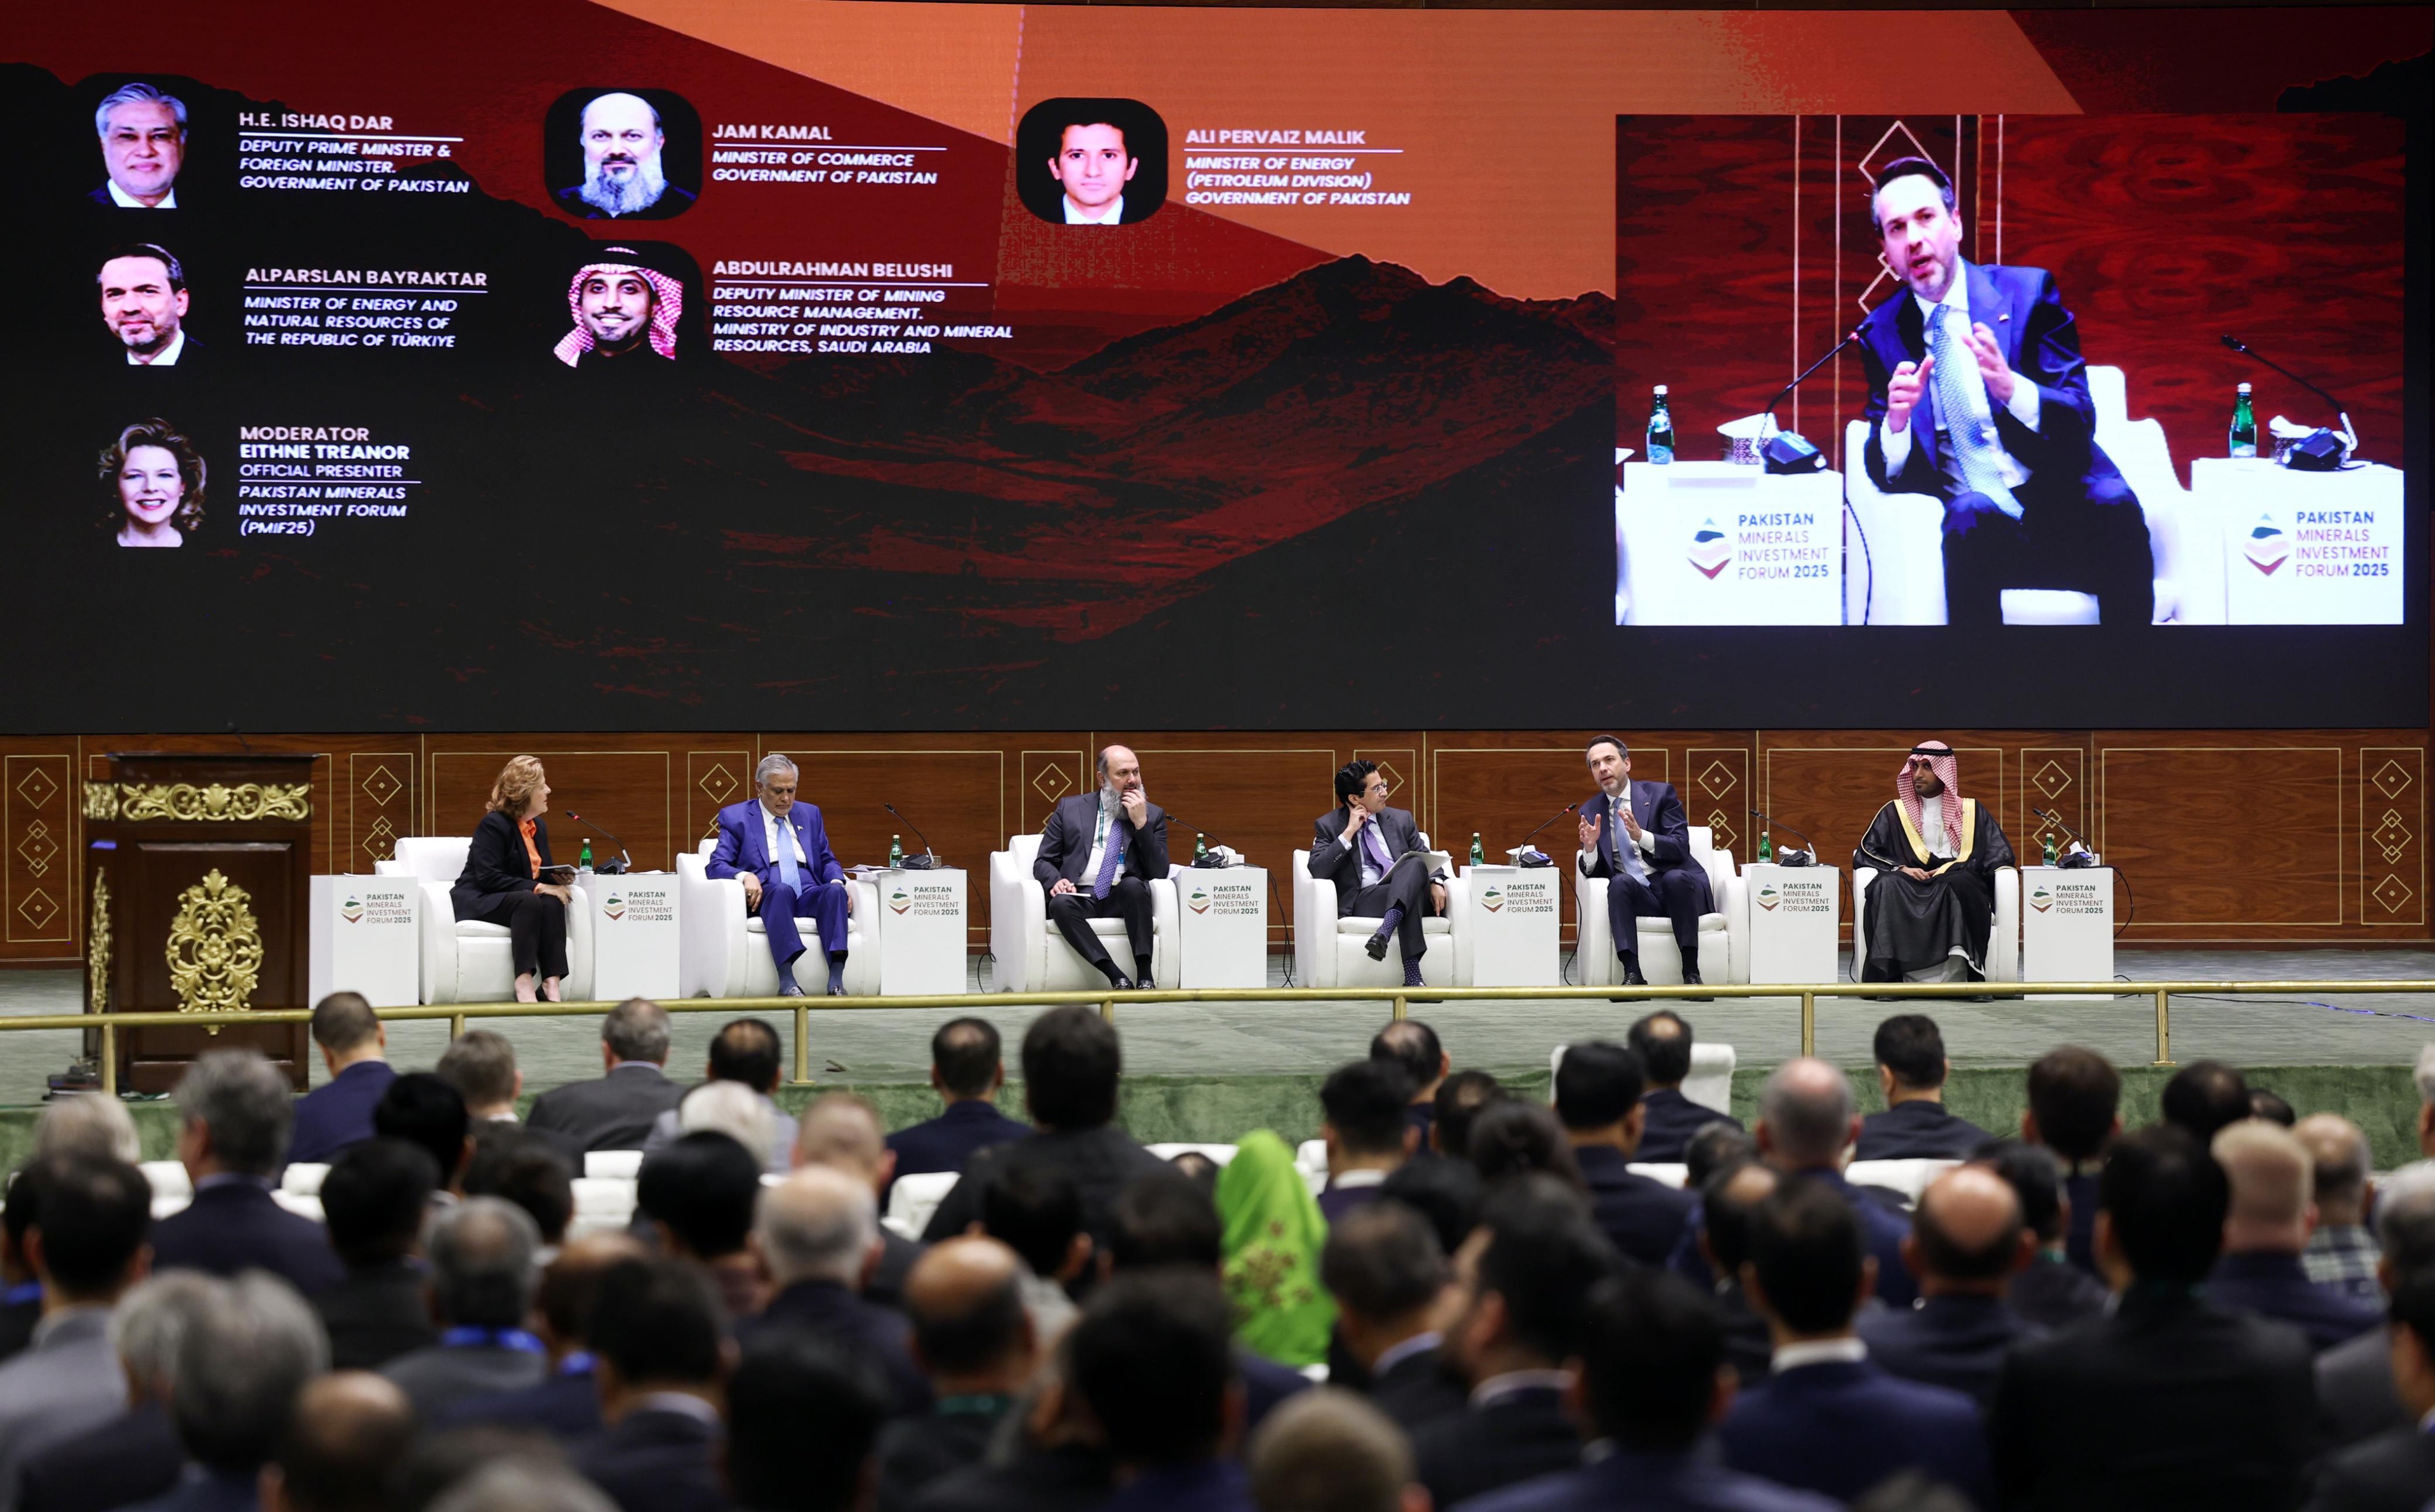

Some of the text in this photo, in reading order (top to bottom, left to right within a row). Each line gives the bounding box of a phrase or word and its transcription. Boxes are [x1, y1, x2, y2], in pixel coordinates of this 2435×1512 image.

[240, 113, 392, 131] H.E. ISHAQ DAR
[712, 125, 832, 140] JAM KAMAL
[1186, 130, 1365, 144] ALI PERVAIZ MALIK
[240, 140, 451, 157] DEPUTY PRIME MINSTER &
[240, 158, 313, 171] FOREIGN
[713, 151, 914, 166] MINISTER OF COMMERCE
[1186, 157, 1355, 169] MINISTER OF ENERGY
[713, 169, 937, 184] GOVERNMENT OF PAKISTAN
[1187, 172, 1371, 190] (PETROLEUM DIVISION)
[240, 176, 469, 193] GOVERNMENT OF PAKISTAN
[1186, 192, 1410, 204] GOVERNMENT OF PAKISTAN
[713, 261, 952, 278] ABDULRAHMAN BELUSHI
[246, 269, 486, 285] ALPARSLAN BAYRAKTAR
[713, 288, 945, 302] DEPUTY MINISTER OF MINING
[245, 297, 457, 311] MINISTER OF ENERGY AND
[713, 305, 800, 317] RESOURCE
[245, 315, 450, 329] NATURAL RESOURCES OF
[713, 323, 1012, 338] MINISTRY OF INDUSTRY AND MINERAL
[247, 332, 276, 344] THE
[281, 333, 358, 345] REPUBLIC
[363, 334, 386, 346] OF
[713, 339, 930, 353] RESOURCES, SAUDI ARABIA
[241, 427, 369, 441] MODERATOR
[241, 444, 409, 459] EITHNE TREANOR
[240, 464, 402, 477] OFFICIAL PRESENTER
[240, 486, 405, 499] PAKISTAN MINERALS
[240, 504, 407, 516] INVESTMENT FORUM
[1739, 514, 1813, 526] PAKISTAN
[2297, 512, 2373, 523] PAKISTAN
[241, 519, 314, 536] (PMIF25)
[1739, 531, 1808, 543] MINERALS
[2298, 530, 2369, 541] MINERALS
[1739, 547, 1829, 562] INVESTMENT
[2297, 547, 2389, 559] INVESTMENT
[1739, 565, 1828, 579] FORUM 2025
[2297, 563, 2388, 577] FORUM 2025
